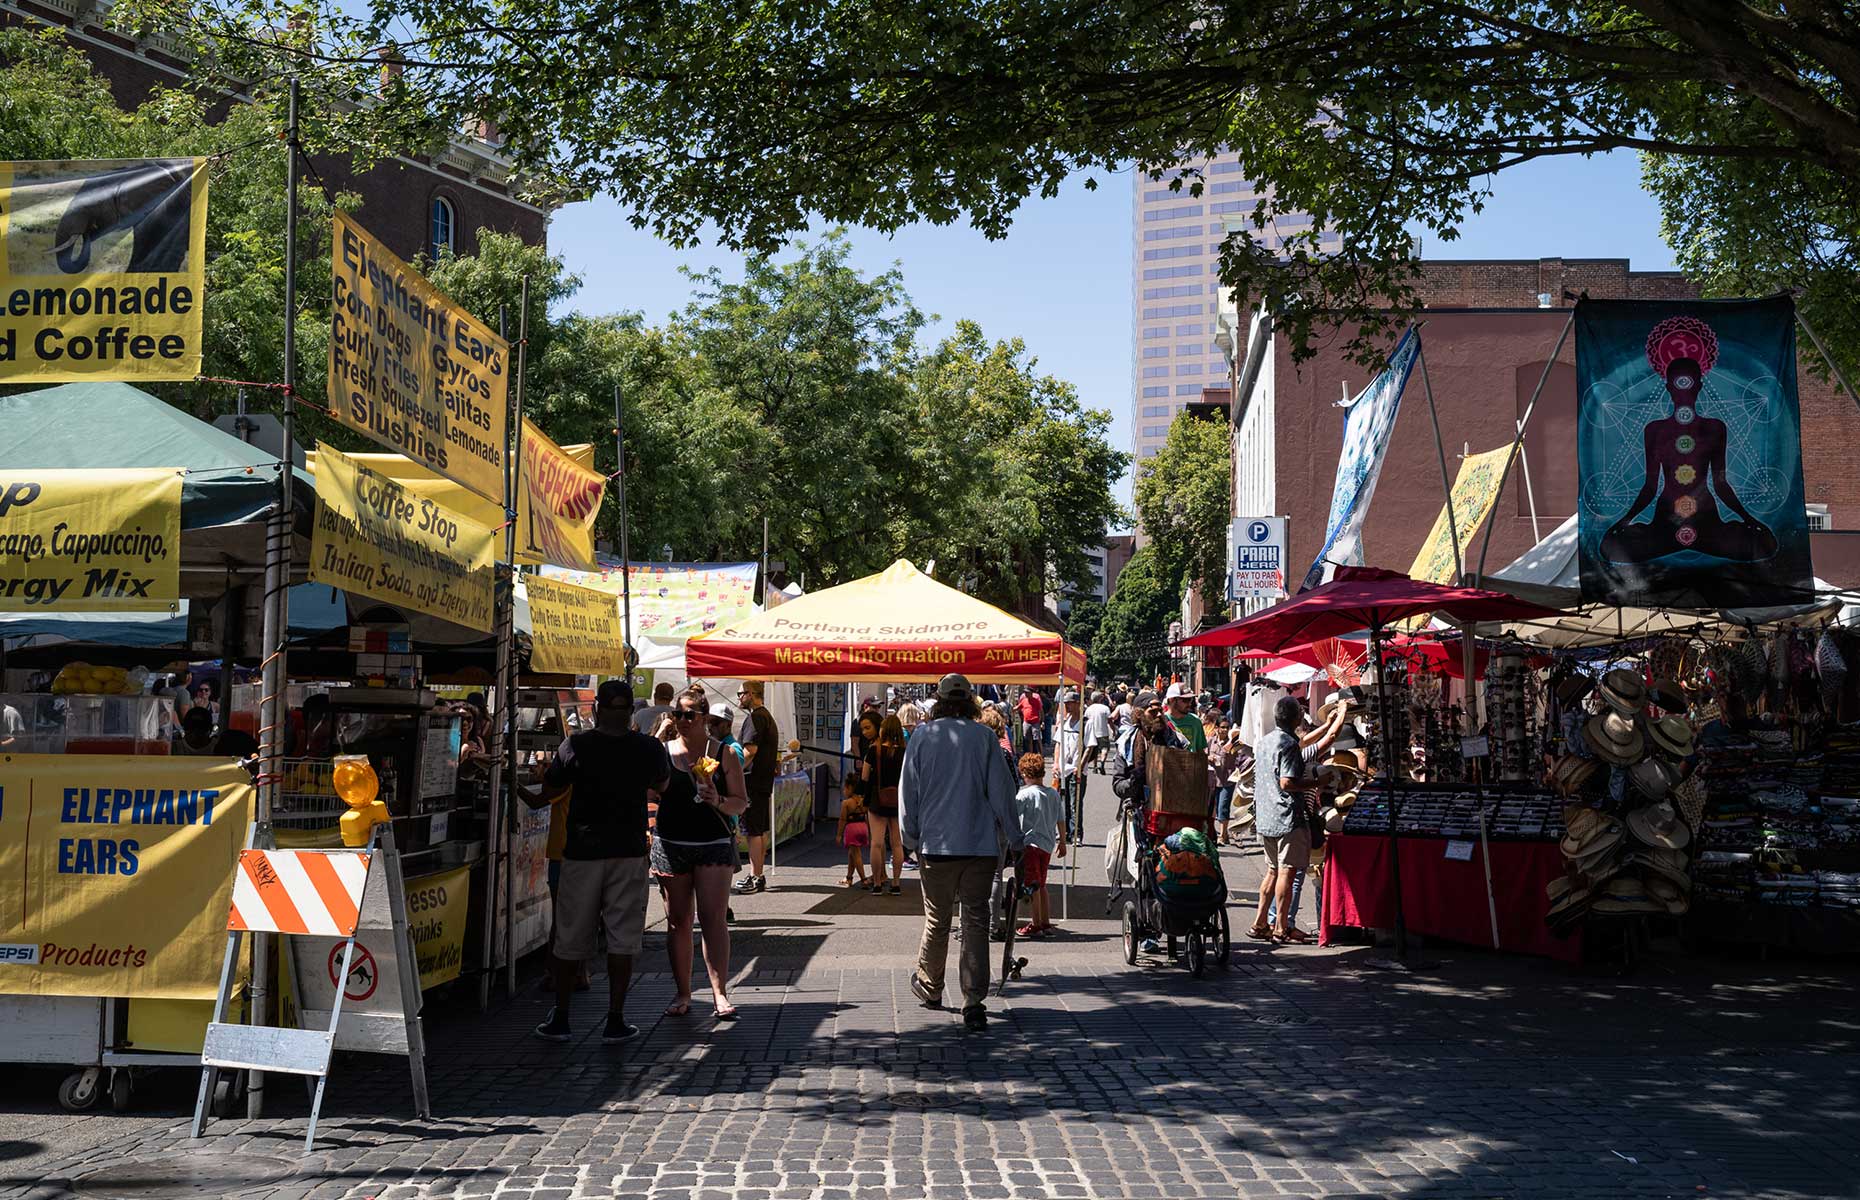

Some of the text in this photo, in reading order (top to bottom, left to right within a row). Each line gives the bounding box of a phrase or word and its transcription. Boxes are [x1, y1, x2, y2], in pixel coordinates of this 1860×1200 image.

[0, 277, 193, 316] emonade
[343, 226, 501, 375] Elephant Ears
[35, 327, 185, 361] Coffee
[335, 276, 490, 400] Corn Dogs Gyros
[333, 313, 490, 431] Curly Fries Fajitas
[334, 346, 500, 467] Fresh Squeezed Lemonade
[352, 392, 448, 469] Slushies
[0, 482, 41, 517] p
[356, 473, 457, 548] Coffee Stop
[51, 522, 167, 564] Cappuccino,
[1253, 525, 1265, 539] P
[82, 568, 156, 598] Mix
[322, 544, 374, 590] Italian
[376, 563, 413, 597] Soda,
[417, 577, 437, 606] and
[440, 584, 469, 619] Energy
[471, 602, 488, 621] Mix
[1237, 572, 1249, 580] PAY
[1252, 572, 1260, 580] TO
[1255, 580, 1278, 588] HOURS
[722, 628, 824, 640] Saturday
[953, 629, 1031, 640] Market
[774, 619, 988, 634] Portland Skidmore
[775, 646, 1059, 664] Market Information ATM HERE
[61, 788, 219, 825] ELEPHANT
[58, 839, 140, 876] EARS
[40, 943, 147, 968] Products
